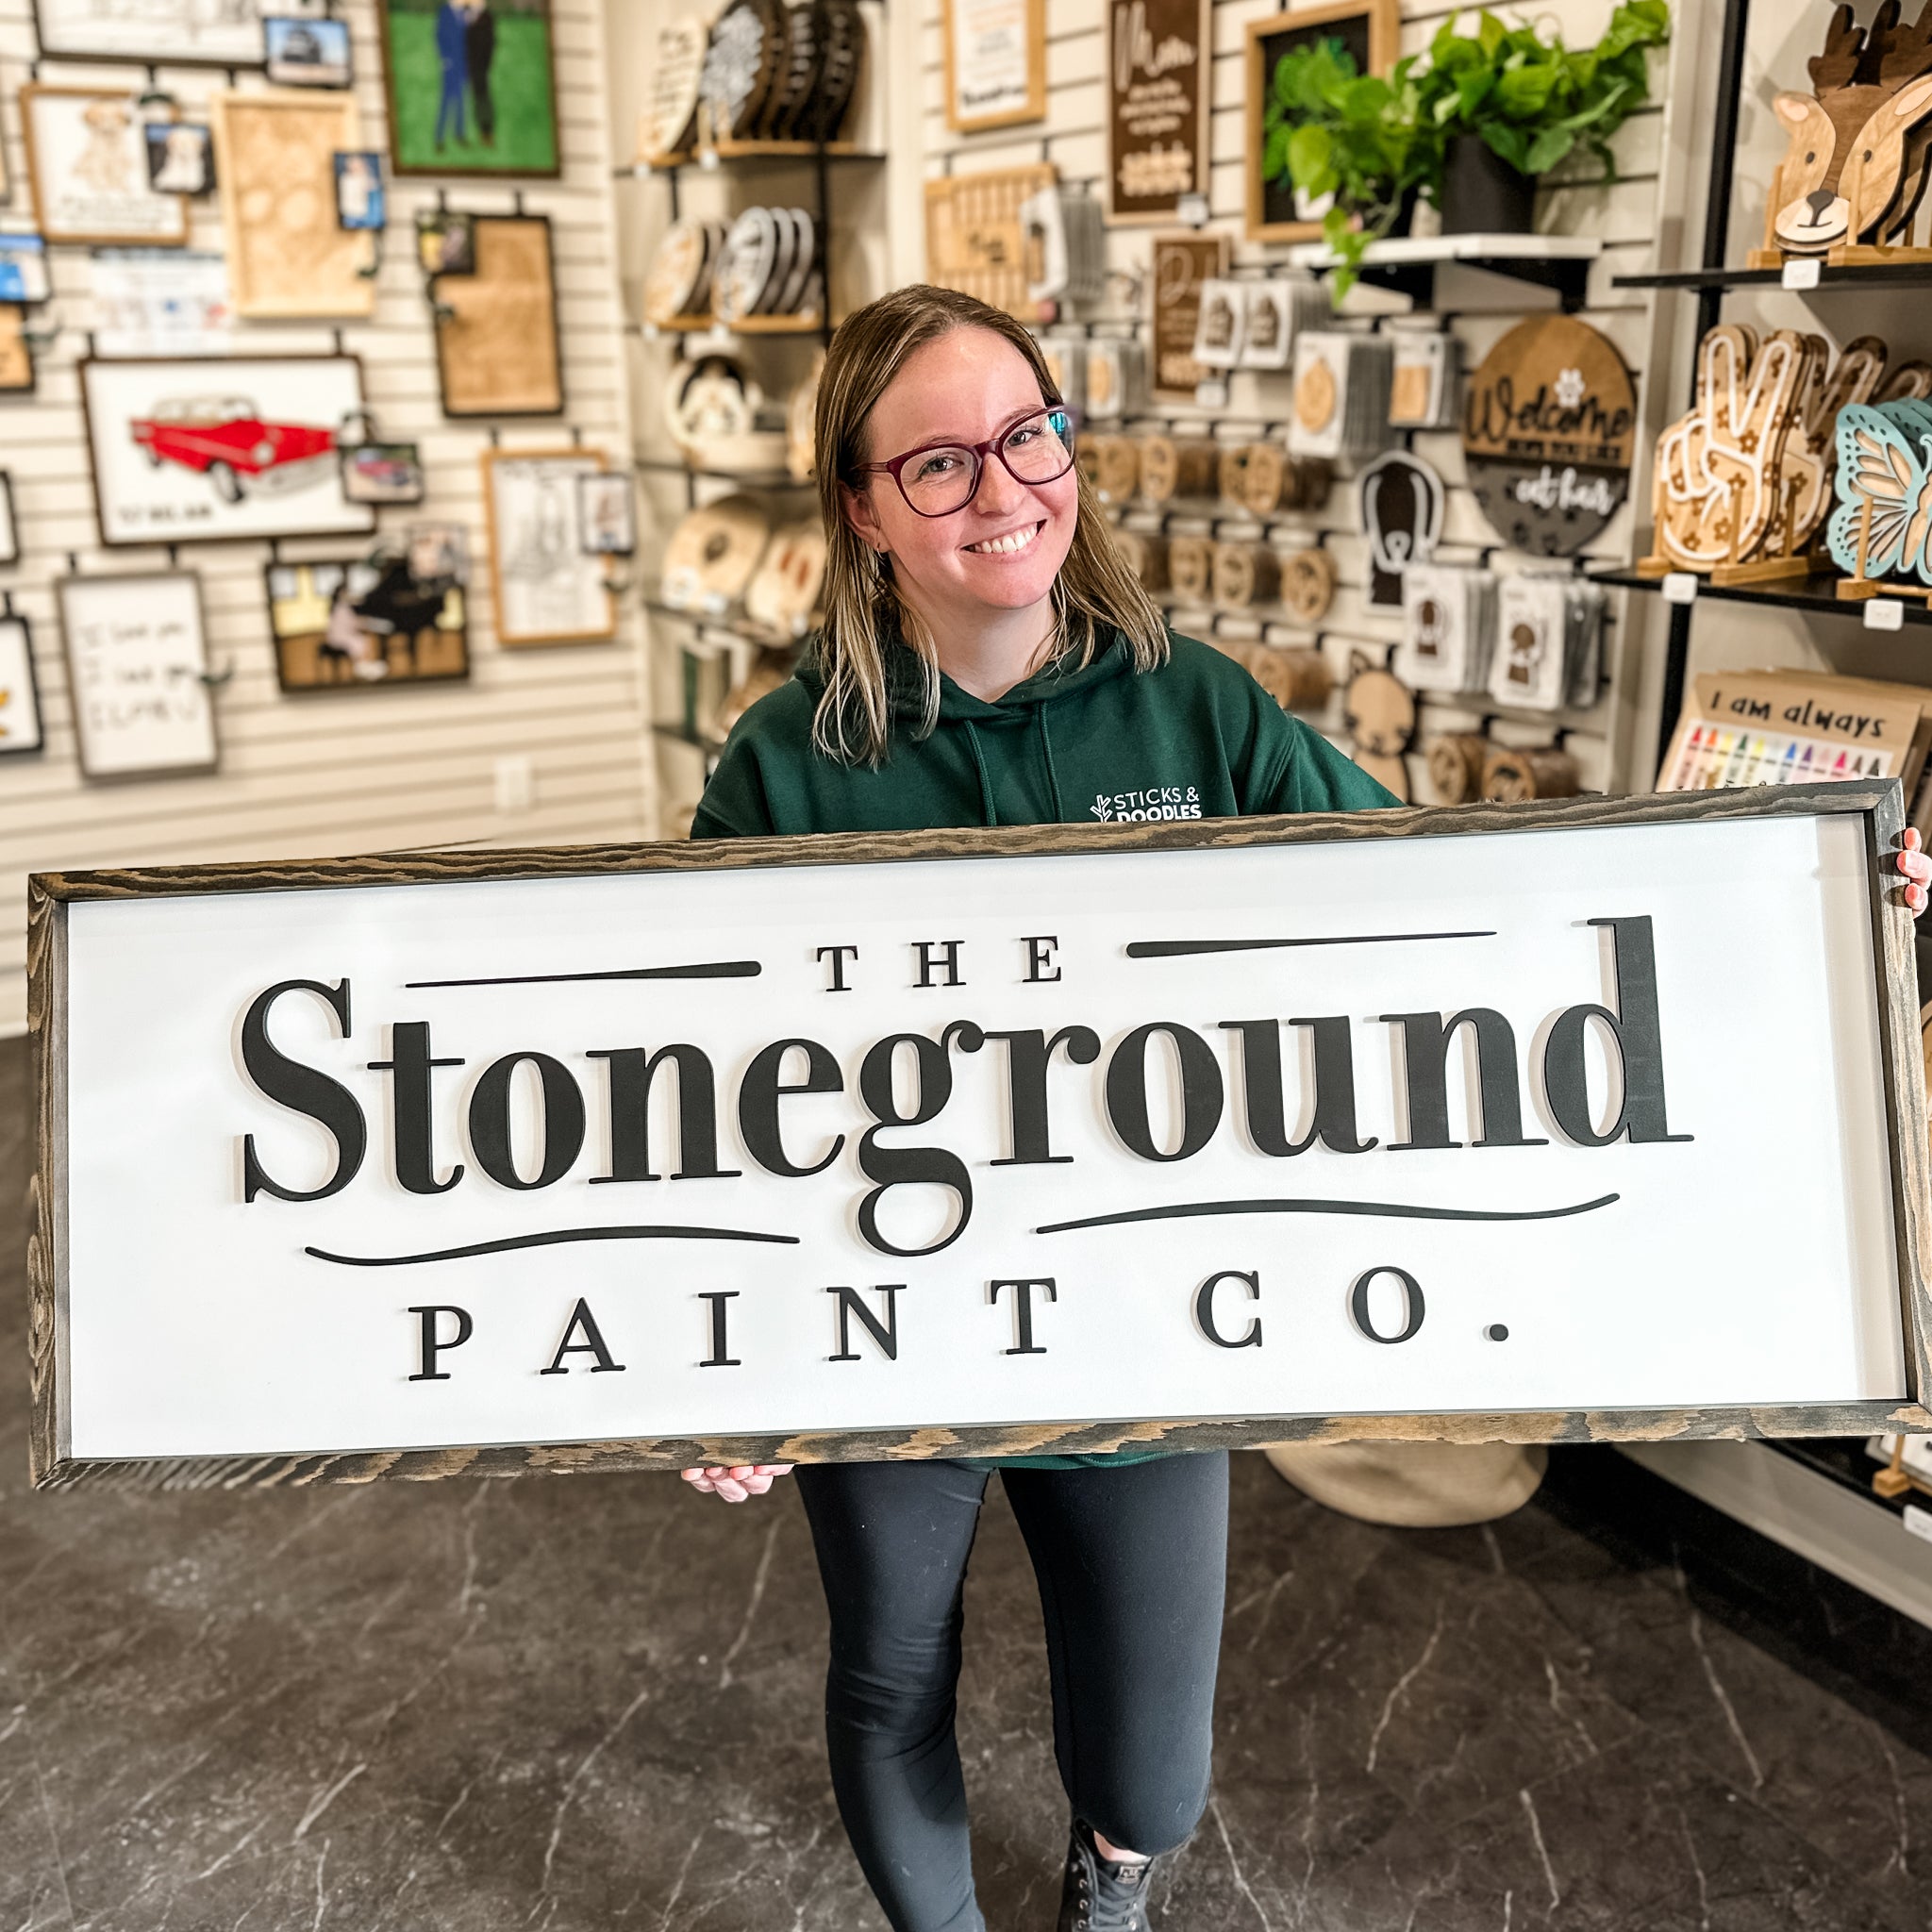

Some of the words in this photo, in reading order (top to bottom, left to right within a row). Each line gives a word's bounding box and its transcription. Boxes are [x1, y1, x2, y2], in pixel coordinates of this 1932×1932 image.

[1467, 376, 1631, 443] Welcome
[1559, 467, 1614, 516] hair
[1710, 691, 1722, 709] I
[1730, 697, 1772, 720] am
[1783, 699, 1886, 739] always
[1113, 787, 1182, 810] STICKS
[1186, 786, 1200, 803] &
[1116, 804, 1203, 823] DOODLES
[817, 936, 1061, 992] THE
[241, 915, 1695, 1257] Stoneground
[408, 1277, 1058, 1382] PAINT
[1196, 1266, 1509, 1349] CO.
